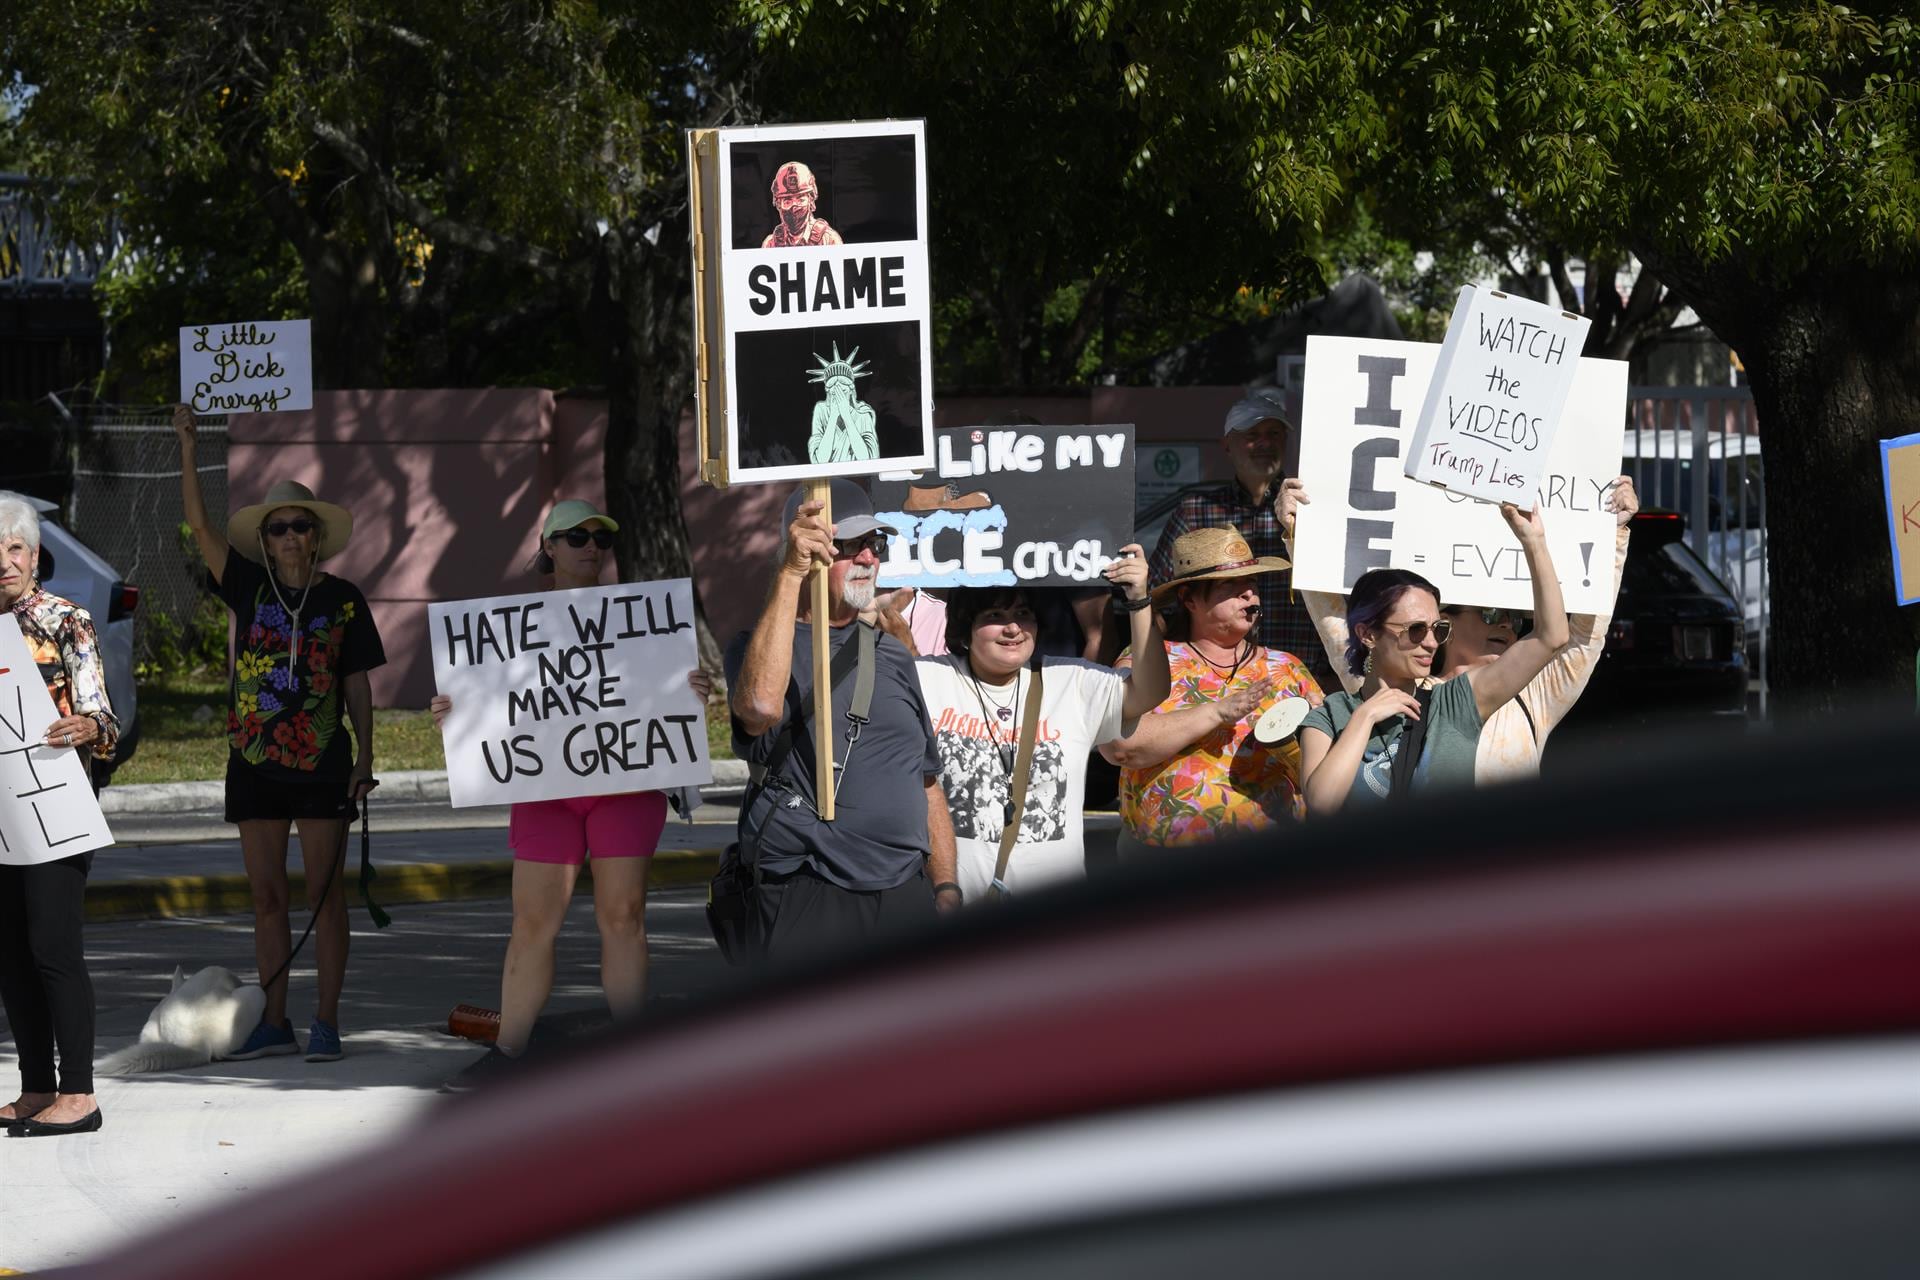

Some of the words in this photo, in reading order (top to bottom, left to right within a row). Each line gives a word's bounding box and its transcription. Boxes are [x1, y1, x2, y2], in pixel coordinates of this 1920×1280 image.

[748, 256, 906, 316] SHAME
[193, 323, 276, 352] Little
[1479, 312, 1567, 365] WATCH
[210, 350, 284, 384] Dick
[1485, 365, 1521, 399] the
[192, 382, 291, 413] Energy
[1449, 395, 1543, 451] VIDEOS
[1055, 433, 1126, 470] MY
[1430, 442, 1484, 485] Trump
[1488, 457, 1526, 489] Lies
[874, 504, 1016, 586] ICE
[443, 601, 551, 667] HATE
[567, 592, 692, 645] WILL
[538, 642, 615, 687] NOT
[508, 676, 626, 726] MAKE
[481, 734, 544, 784] US
[562, 715, 698, 777] GREAT
